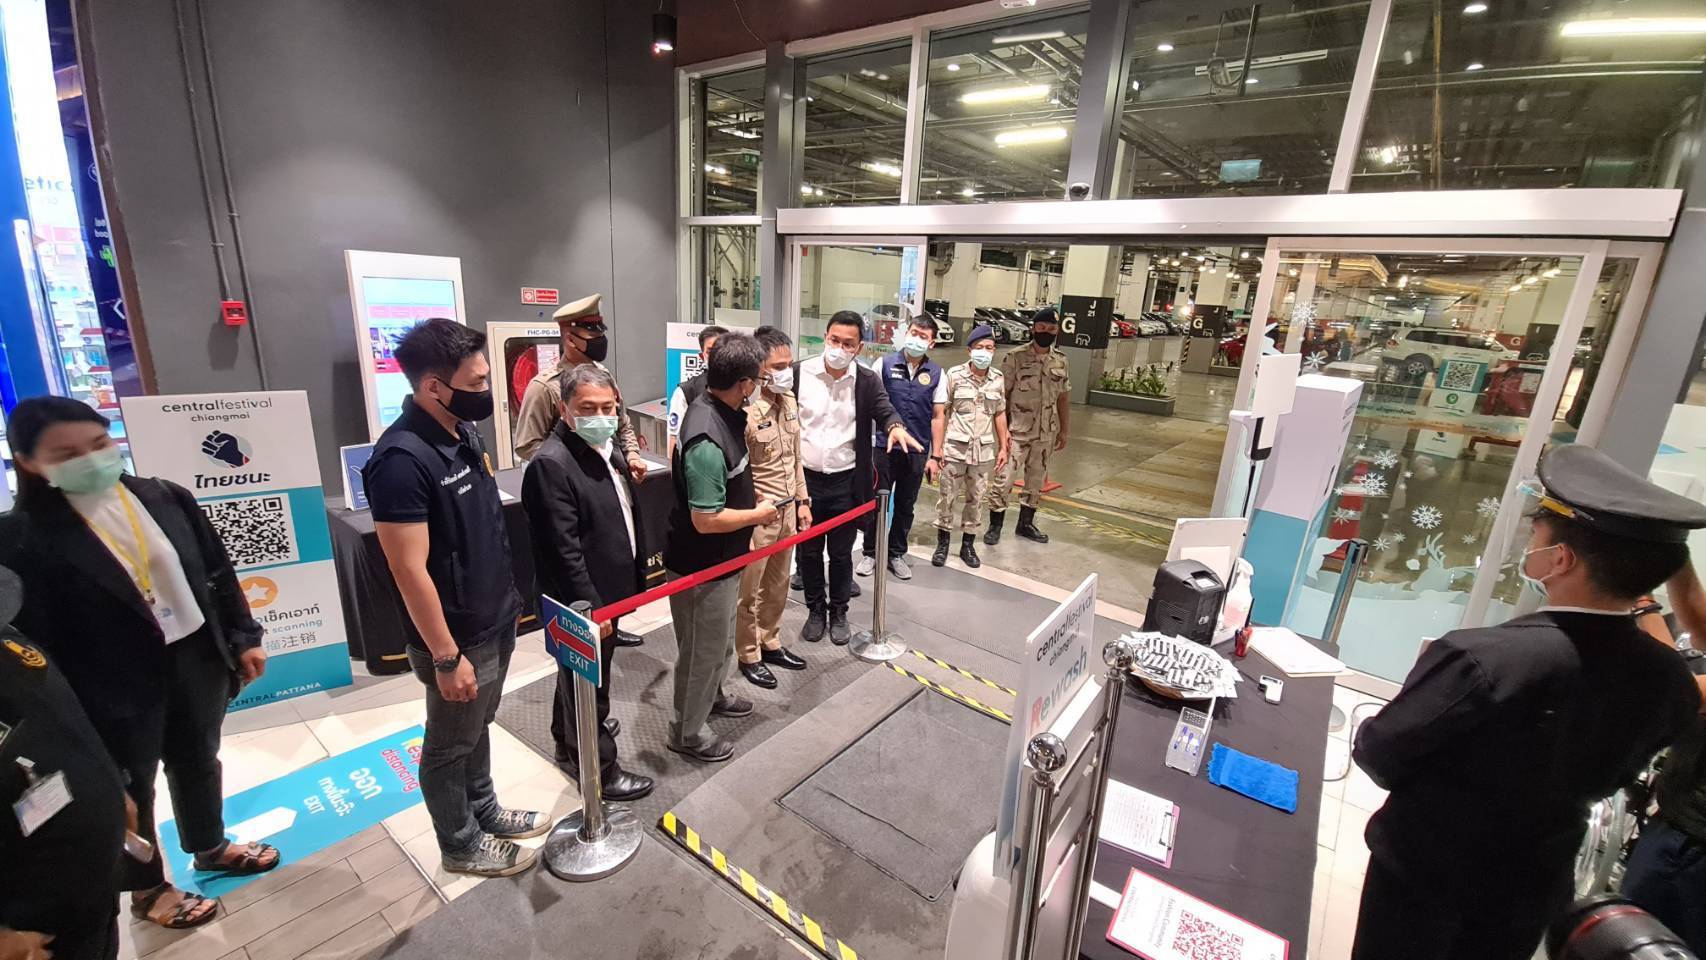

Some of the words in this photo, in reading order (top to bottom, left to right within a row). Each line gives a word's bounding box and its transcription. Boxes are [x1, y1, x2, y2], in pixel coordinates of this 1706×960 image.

[1089, 300, 1097, 310] J
[1061, 316, 1076, 334] G
[1193, 318, 1203, 329] G
[1510, 336, 1521, 346] G
[162, 398, 272, 413] centralfestival
[191, 412, 250, 422] chiangmai
[194, 473, 271, 489] ไทยชนะ
[272, 619, 323, 634] scanning
[1036, 588, 1094, 662] centralfestival
[569, 651, 590, 672] EXIT
[228, 683, 321, 708] CENTRALPATTANA
[1031, 645, 1088, 728] Rewash
[382, 748, 419, 793] distancing
[349, 768, 382, 800] ออก
[303, 795, 325, 814] EXIT
